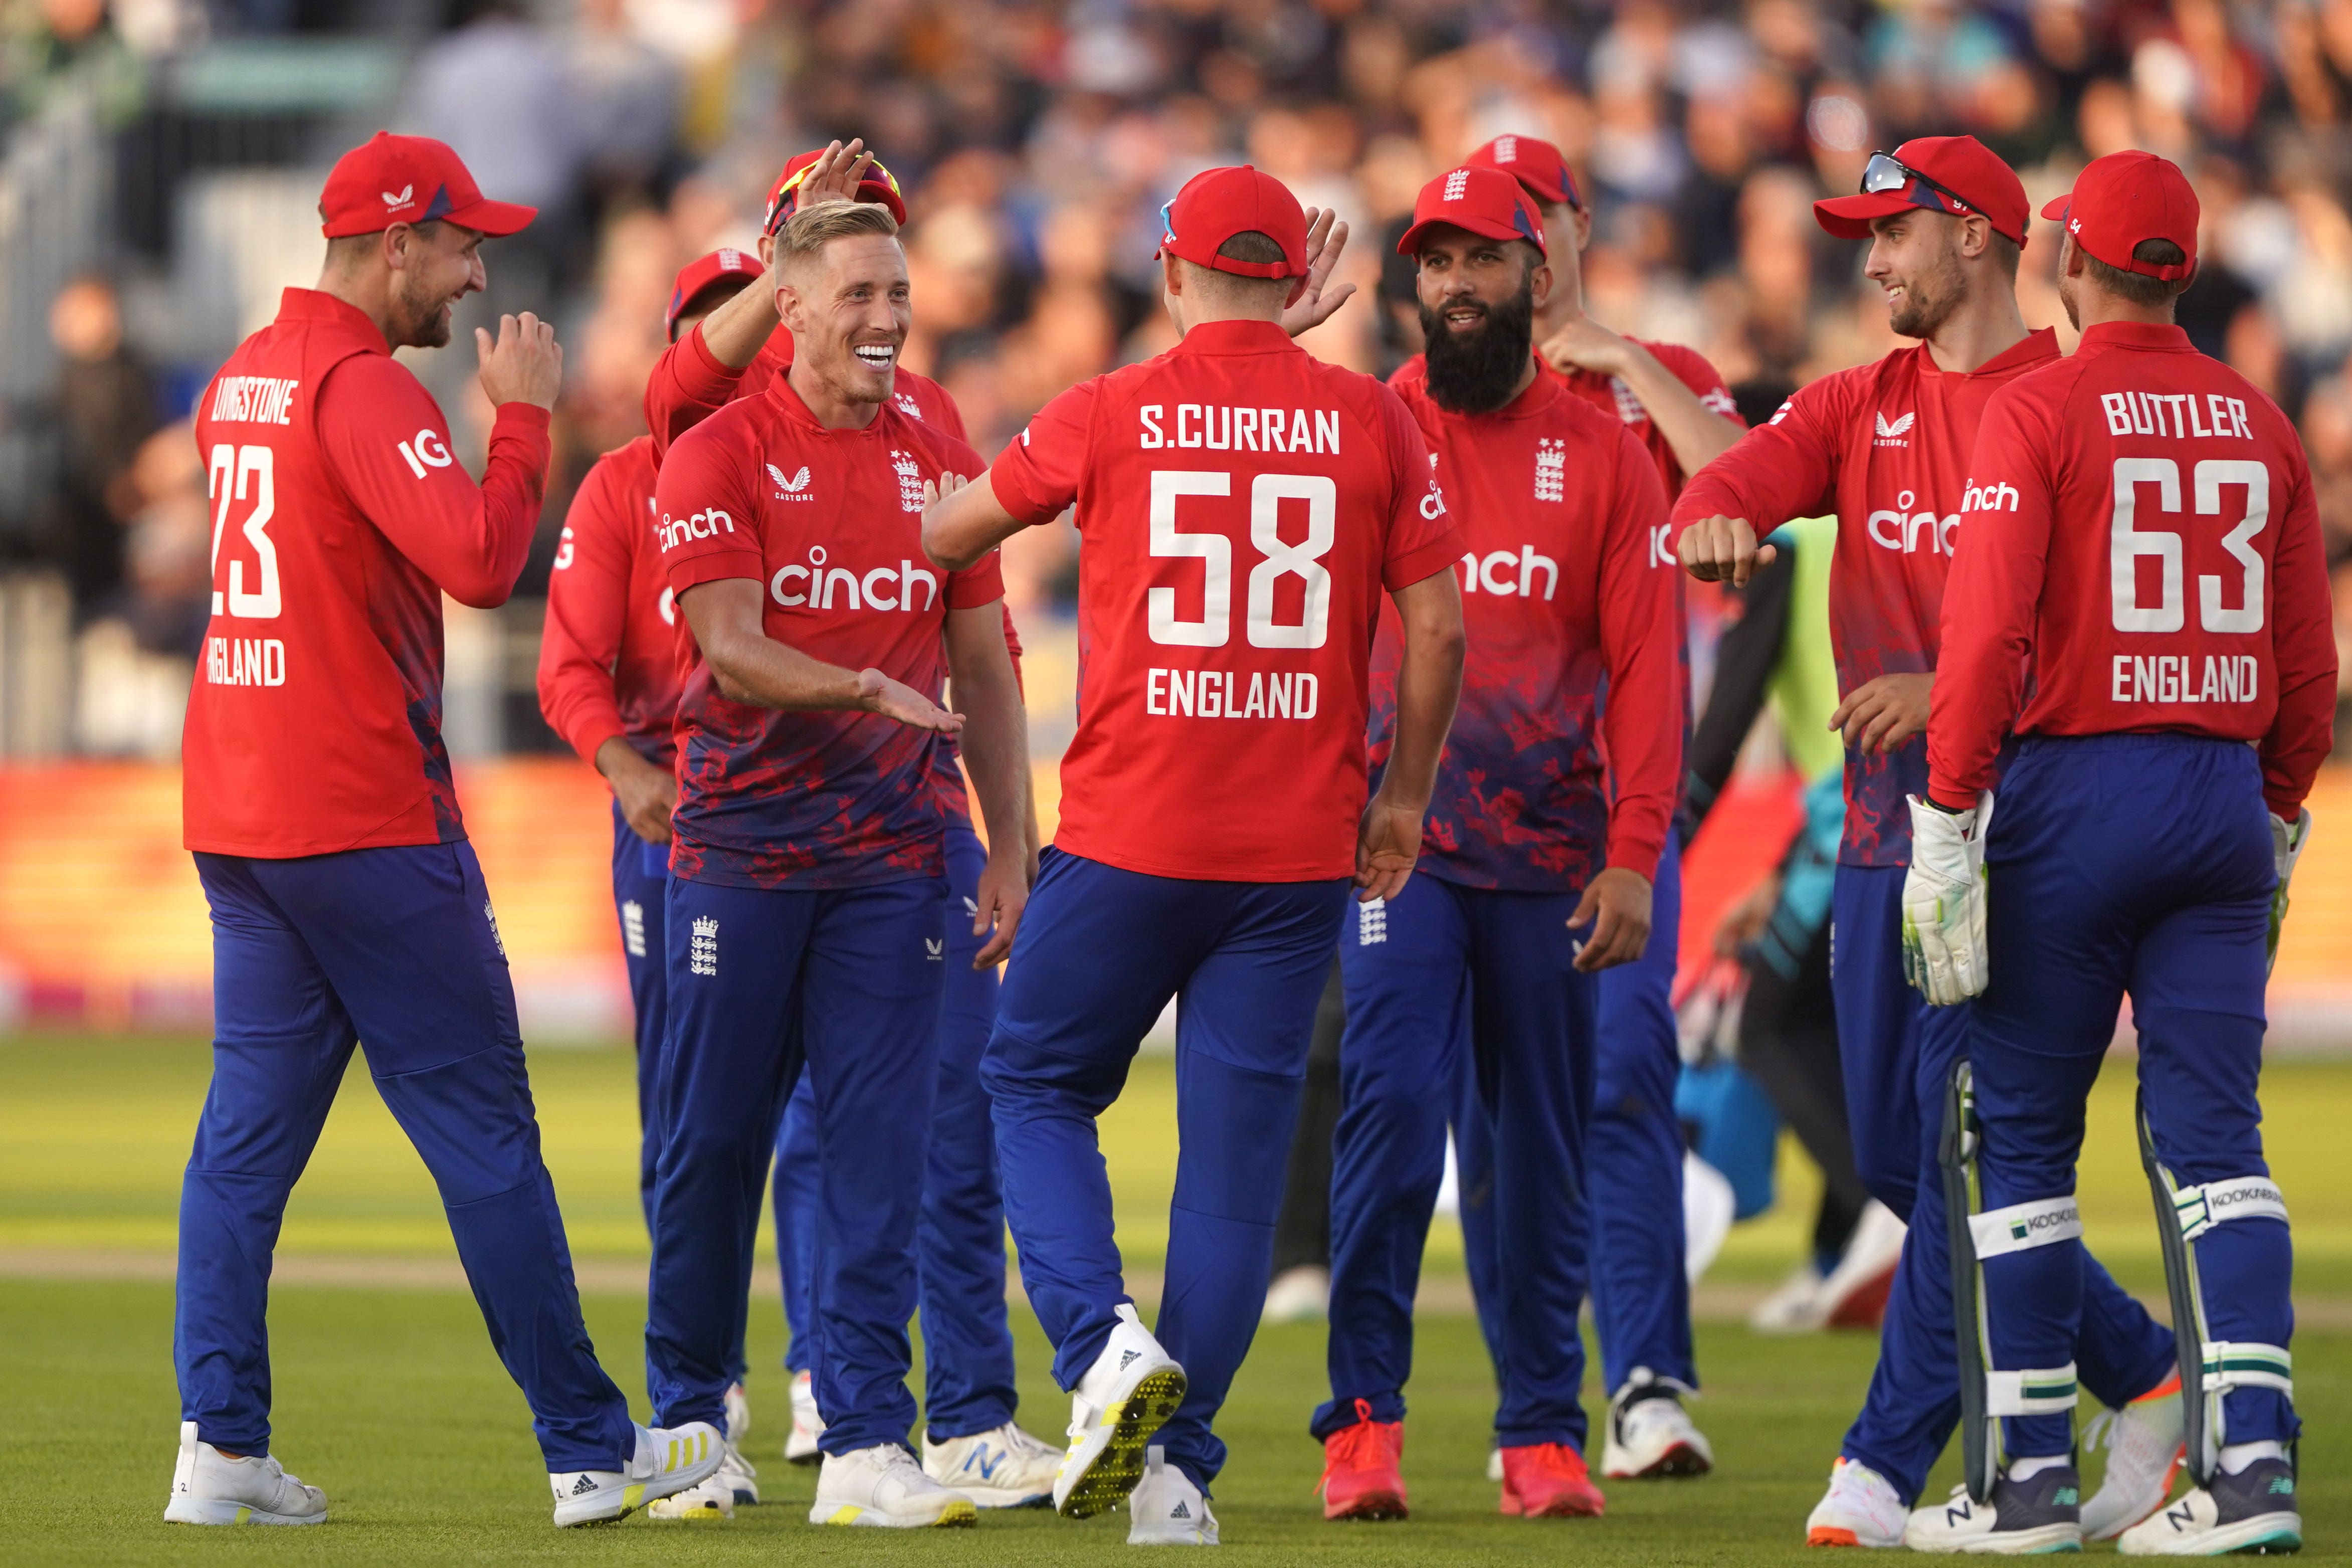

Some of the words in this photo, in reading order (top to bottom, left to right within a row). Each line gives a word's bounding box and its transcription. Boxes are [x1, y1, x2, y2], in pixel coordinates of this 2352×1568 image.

[2070, 218, 2082, 234] 54
[1140, 404, 1340, 455] S.CURRAN
[2101, 391, 2253, 440] BUTTLER
[397, 429, 452, 479] IG
[775, 492, 814, 501] CASTORE
[209, 444, 282, 619] 23
[659, 507, 735, 553] cinch
[2111, 458, 2269, 633] 63
[771, 545, 937, 611] cinch
[1148, 470, 1336, 649] 58
[1146, 668, 1318, 719] ENGLAND
[2112, 655, 2257, 703] ENGLAND
[180, 1482, 187, 1492] 2
[556, 1488, 563, 1498] 2
[572, 1484, 599, 1496] adidas
